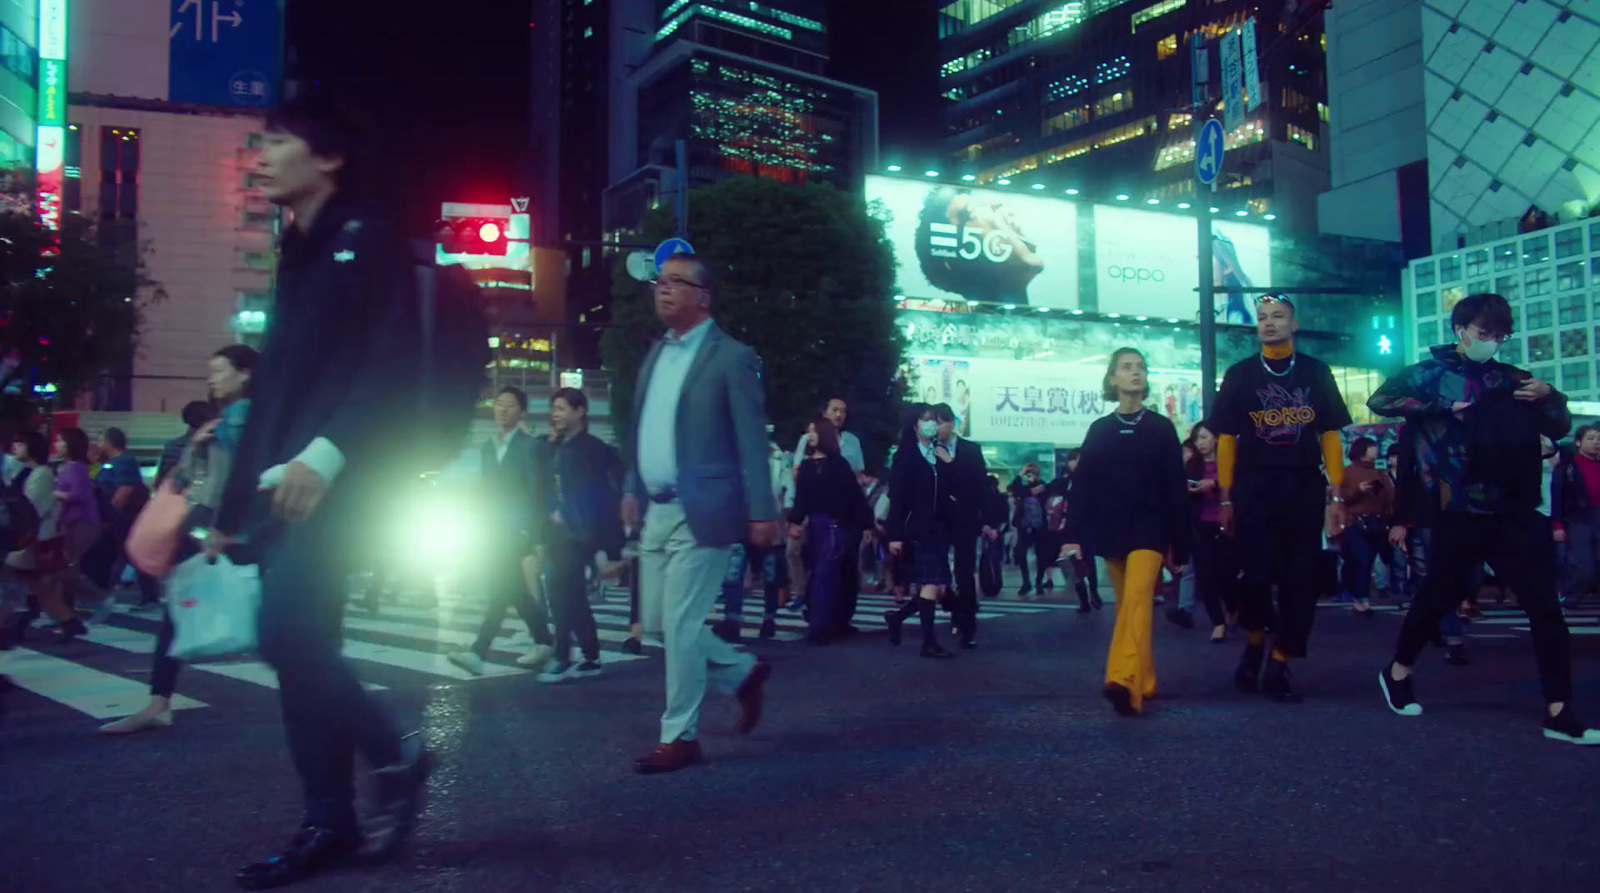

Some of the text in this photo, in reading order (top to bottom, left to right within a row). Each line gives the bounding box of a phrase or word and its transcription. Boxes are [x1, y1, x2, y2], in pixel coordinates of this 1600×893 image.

[959, 225, 1013, 263] 5G
[1107, 264, 1165, 284] oppo
[1248, 405, 1316, 429] YOKO
